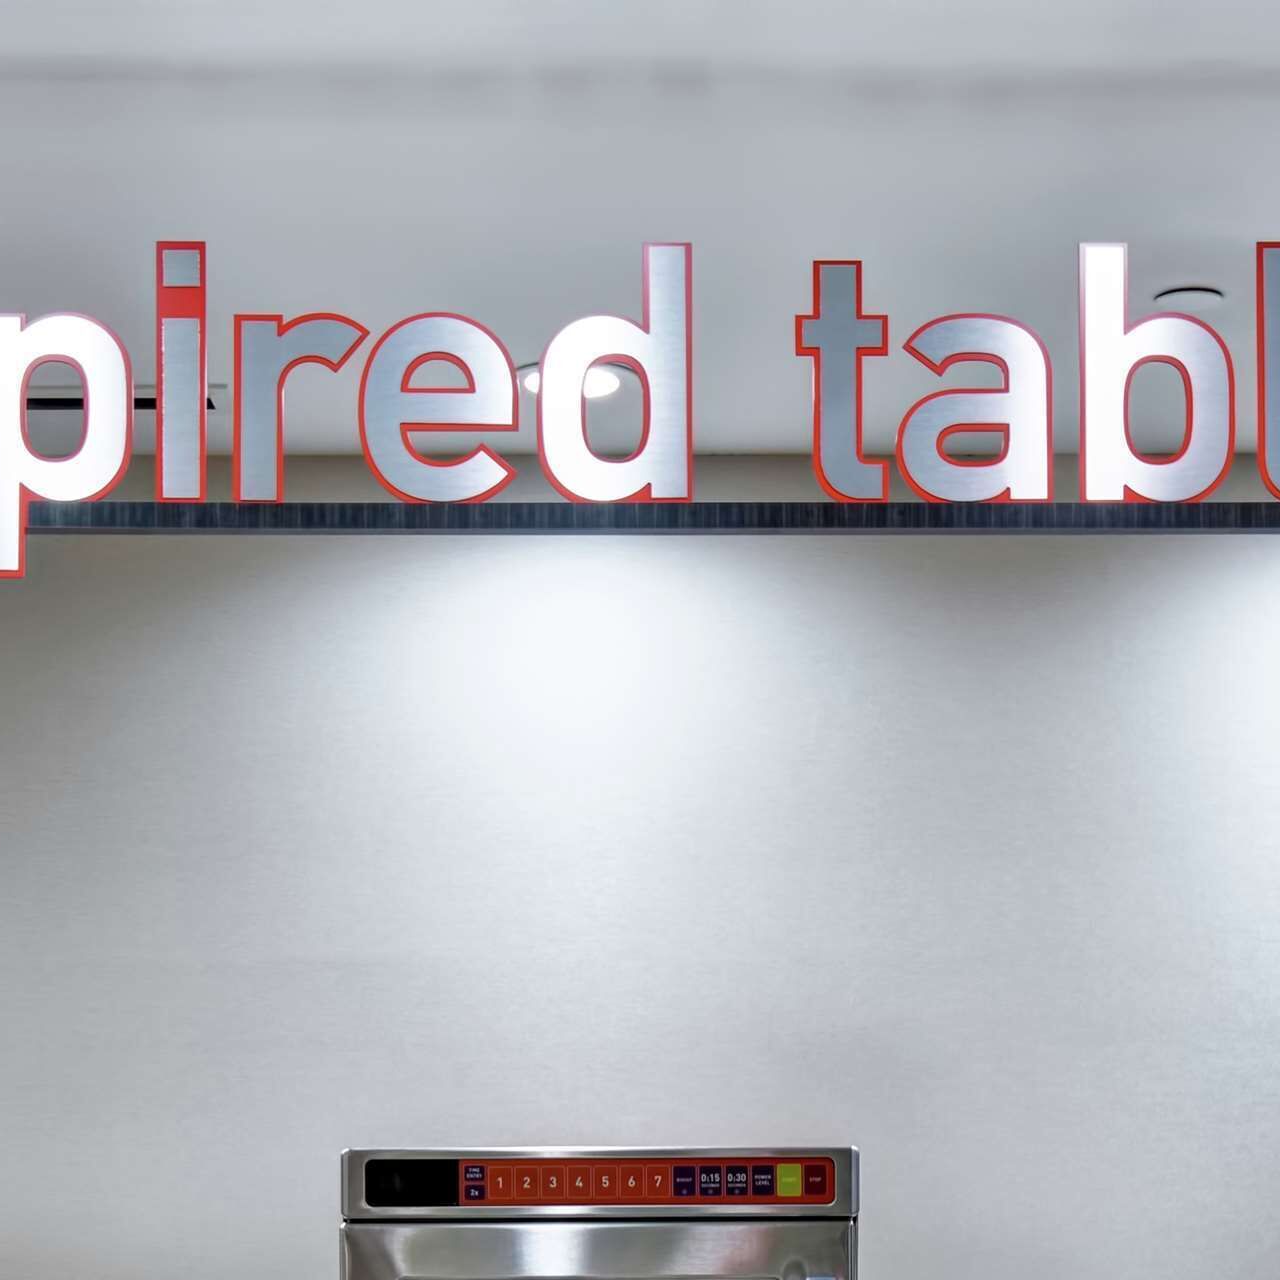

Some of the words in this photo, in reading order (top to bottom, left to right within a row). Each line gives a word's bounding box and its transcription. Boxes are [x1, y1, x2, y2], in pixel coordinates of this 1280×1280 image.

[497, 1177, 503, 1189] 1
[523, 1177, 531, 1188] 2
[549, 1177, 557, 1188] 3
[575, 1177, 583, 1188] 4
[601, 1176, 609, 1188] 5
[628, 1176, 636, 1188] 6
[654, 1175, 662, 1188] 7
[701, 1173, 720, 1183] 0:15
[727, 1173, 747, 1183] 0:30
